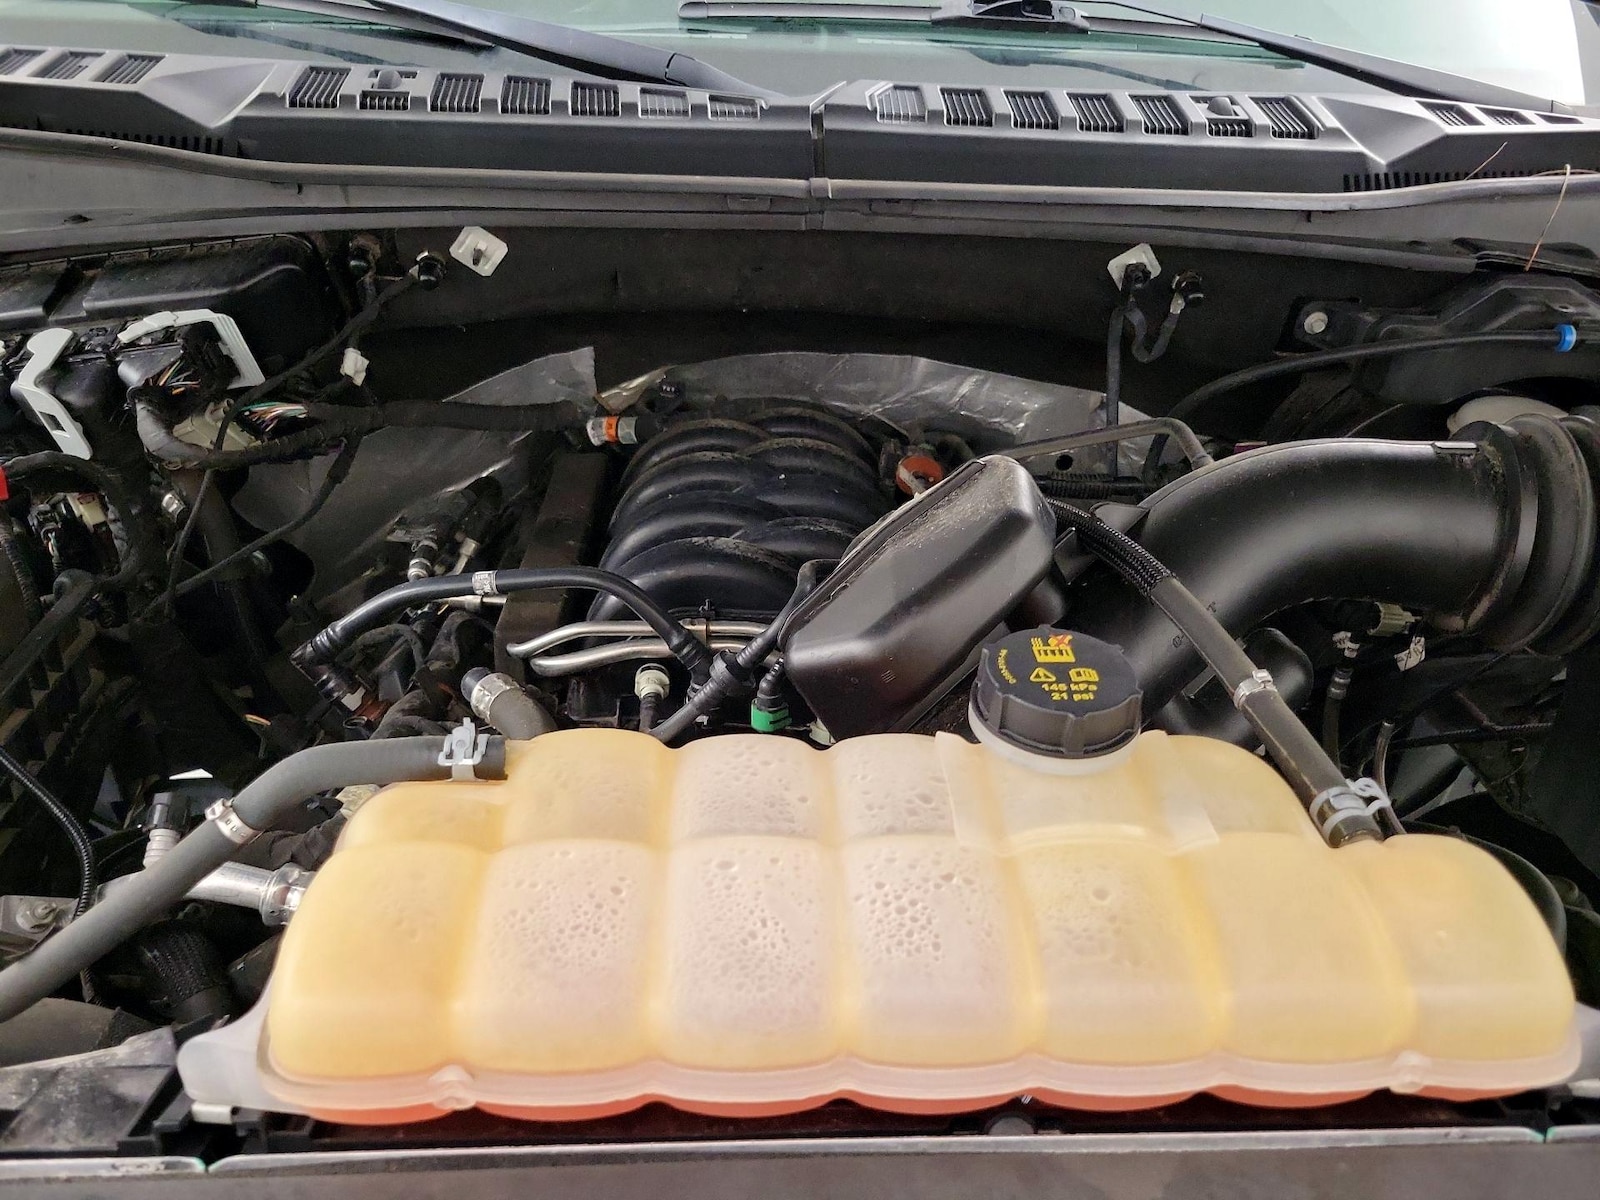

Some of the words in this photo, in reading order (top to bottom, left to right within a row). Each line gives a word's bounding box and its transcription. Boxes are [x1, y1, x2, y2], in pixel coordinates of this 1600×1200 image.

[1069, 683, 1098, 691] kPa
[1051, 692, 1069, 700] 21
[1072, 692, 1095, 701] psi
